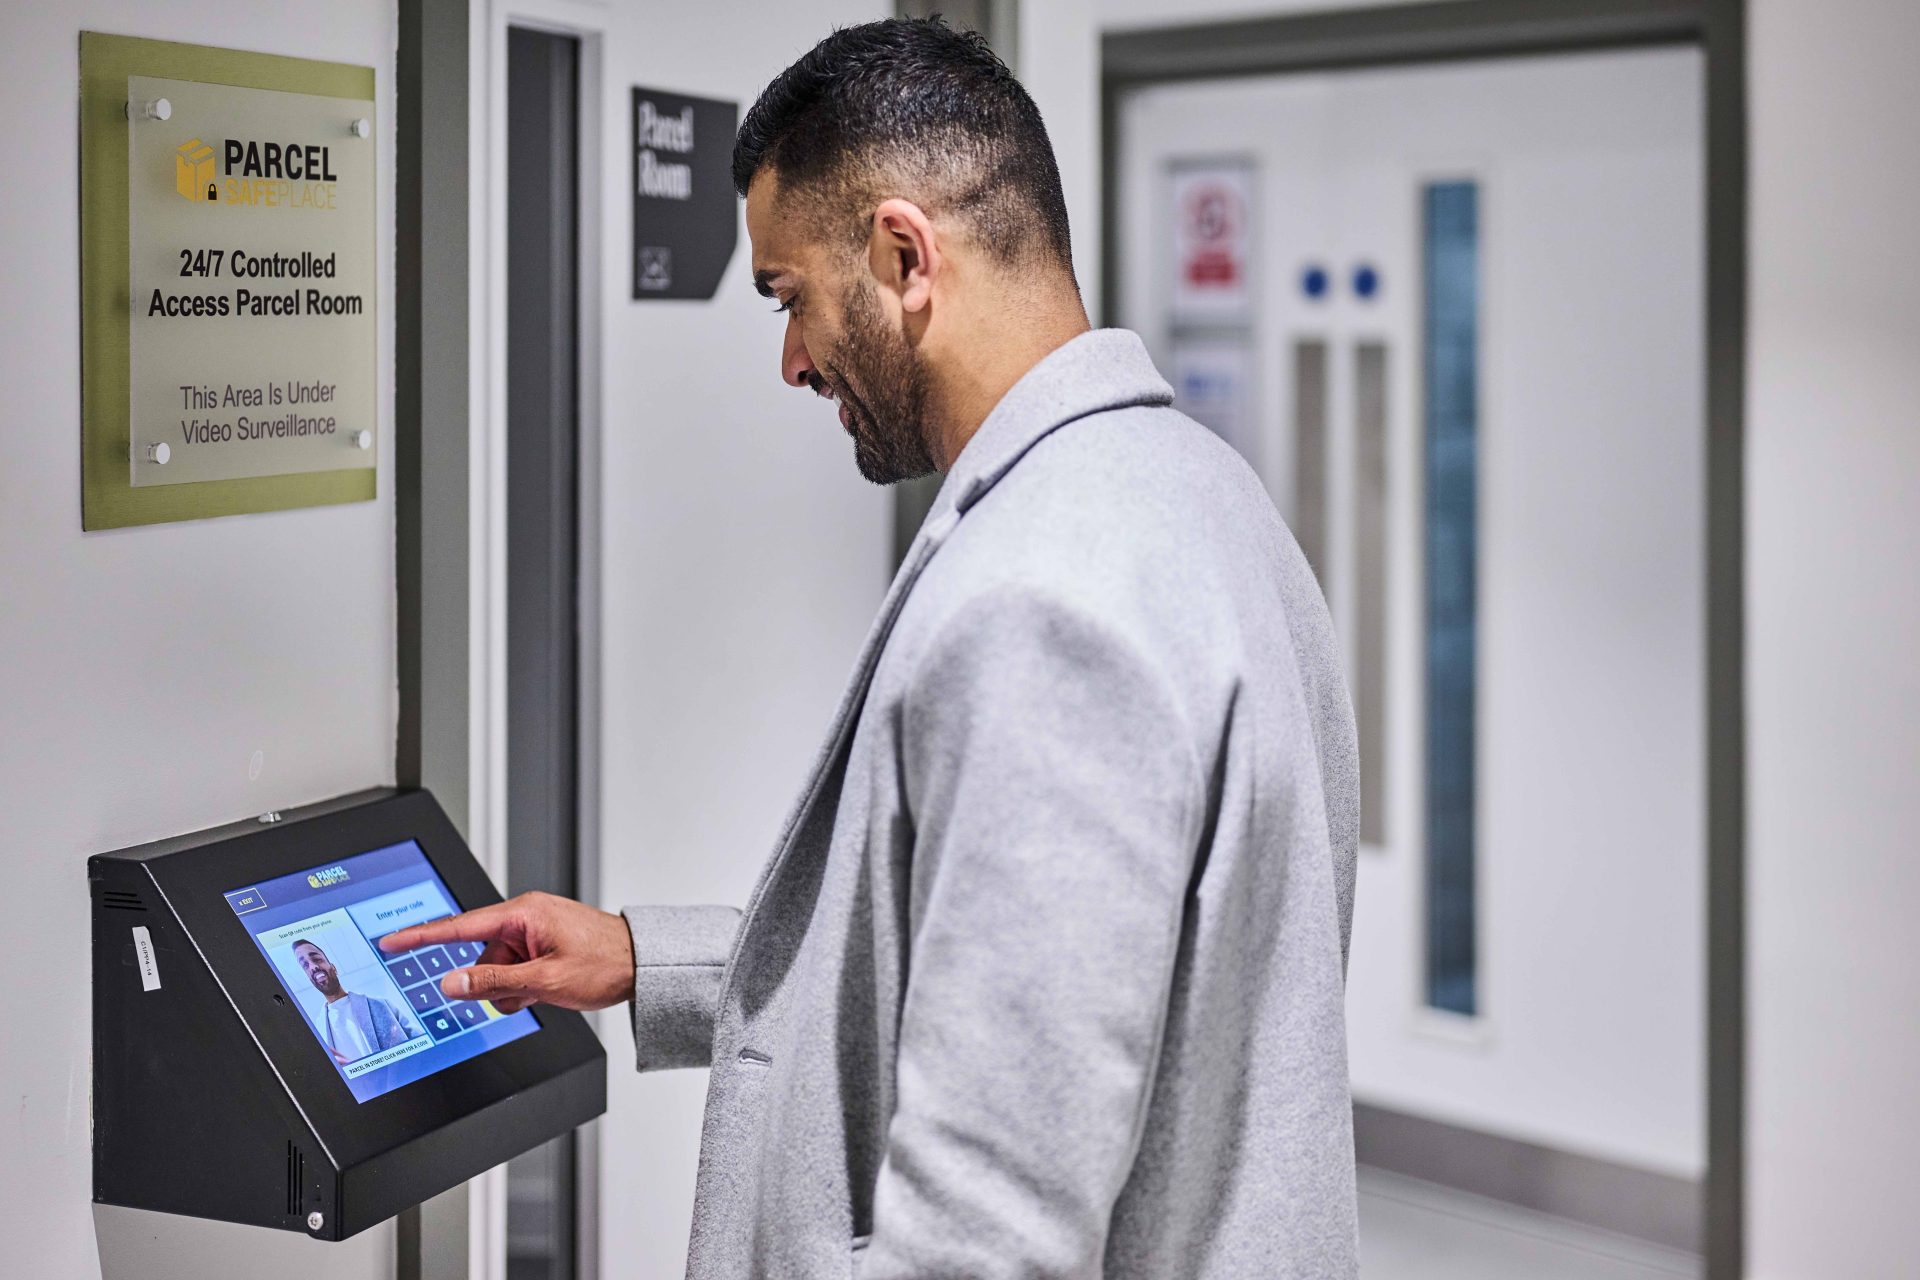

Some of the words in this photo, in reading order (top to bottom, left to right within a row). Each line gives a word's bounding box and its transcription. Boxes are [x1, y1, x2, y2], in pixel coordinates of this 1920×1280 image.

[224, 139, 337, 181] PARCEL
[224, 179, 337, 209] SAFEPLACE
[180, 249, 224, 277] 24/7
[231, 250, 336, 278] Controlled
[148, 289, 229, 316] Access
[236, 289, 300, 315] Parcel
[306, 289, 362, 315] Room
[180, 384, 217, 409] This
[222, 384, 262, 407] Area
[268, 382, 282, 405] Is
[288, 380, 336, 404] Under
[181, 420, 231, 444] Video
[237, 413, 336, 440] Surveillance
[316, 866, 347, 881] PARCEL
[376, 911, 394, 920] Enter
[395, 905, 408, 916] your
[410, 900, 424, 910] code
[404, 967, 411, 977] 4
[431, 957, 440, 967] 5
[459, 947, 467, 957] 6
[420, 993, 428, 1003] 7
[465, 1009, 474, 1019] 0
[349, 1065, 365, 1075] PARCEL
